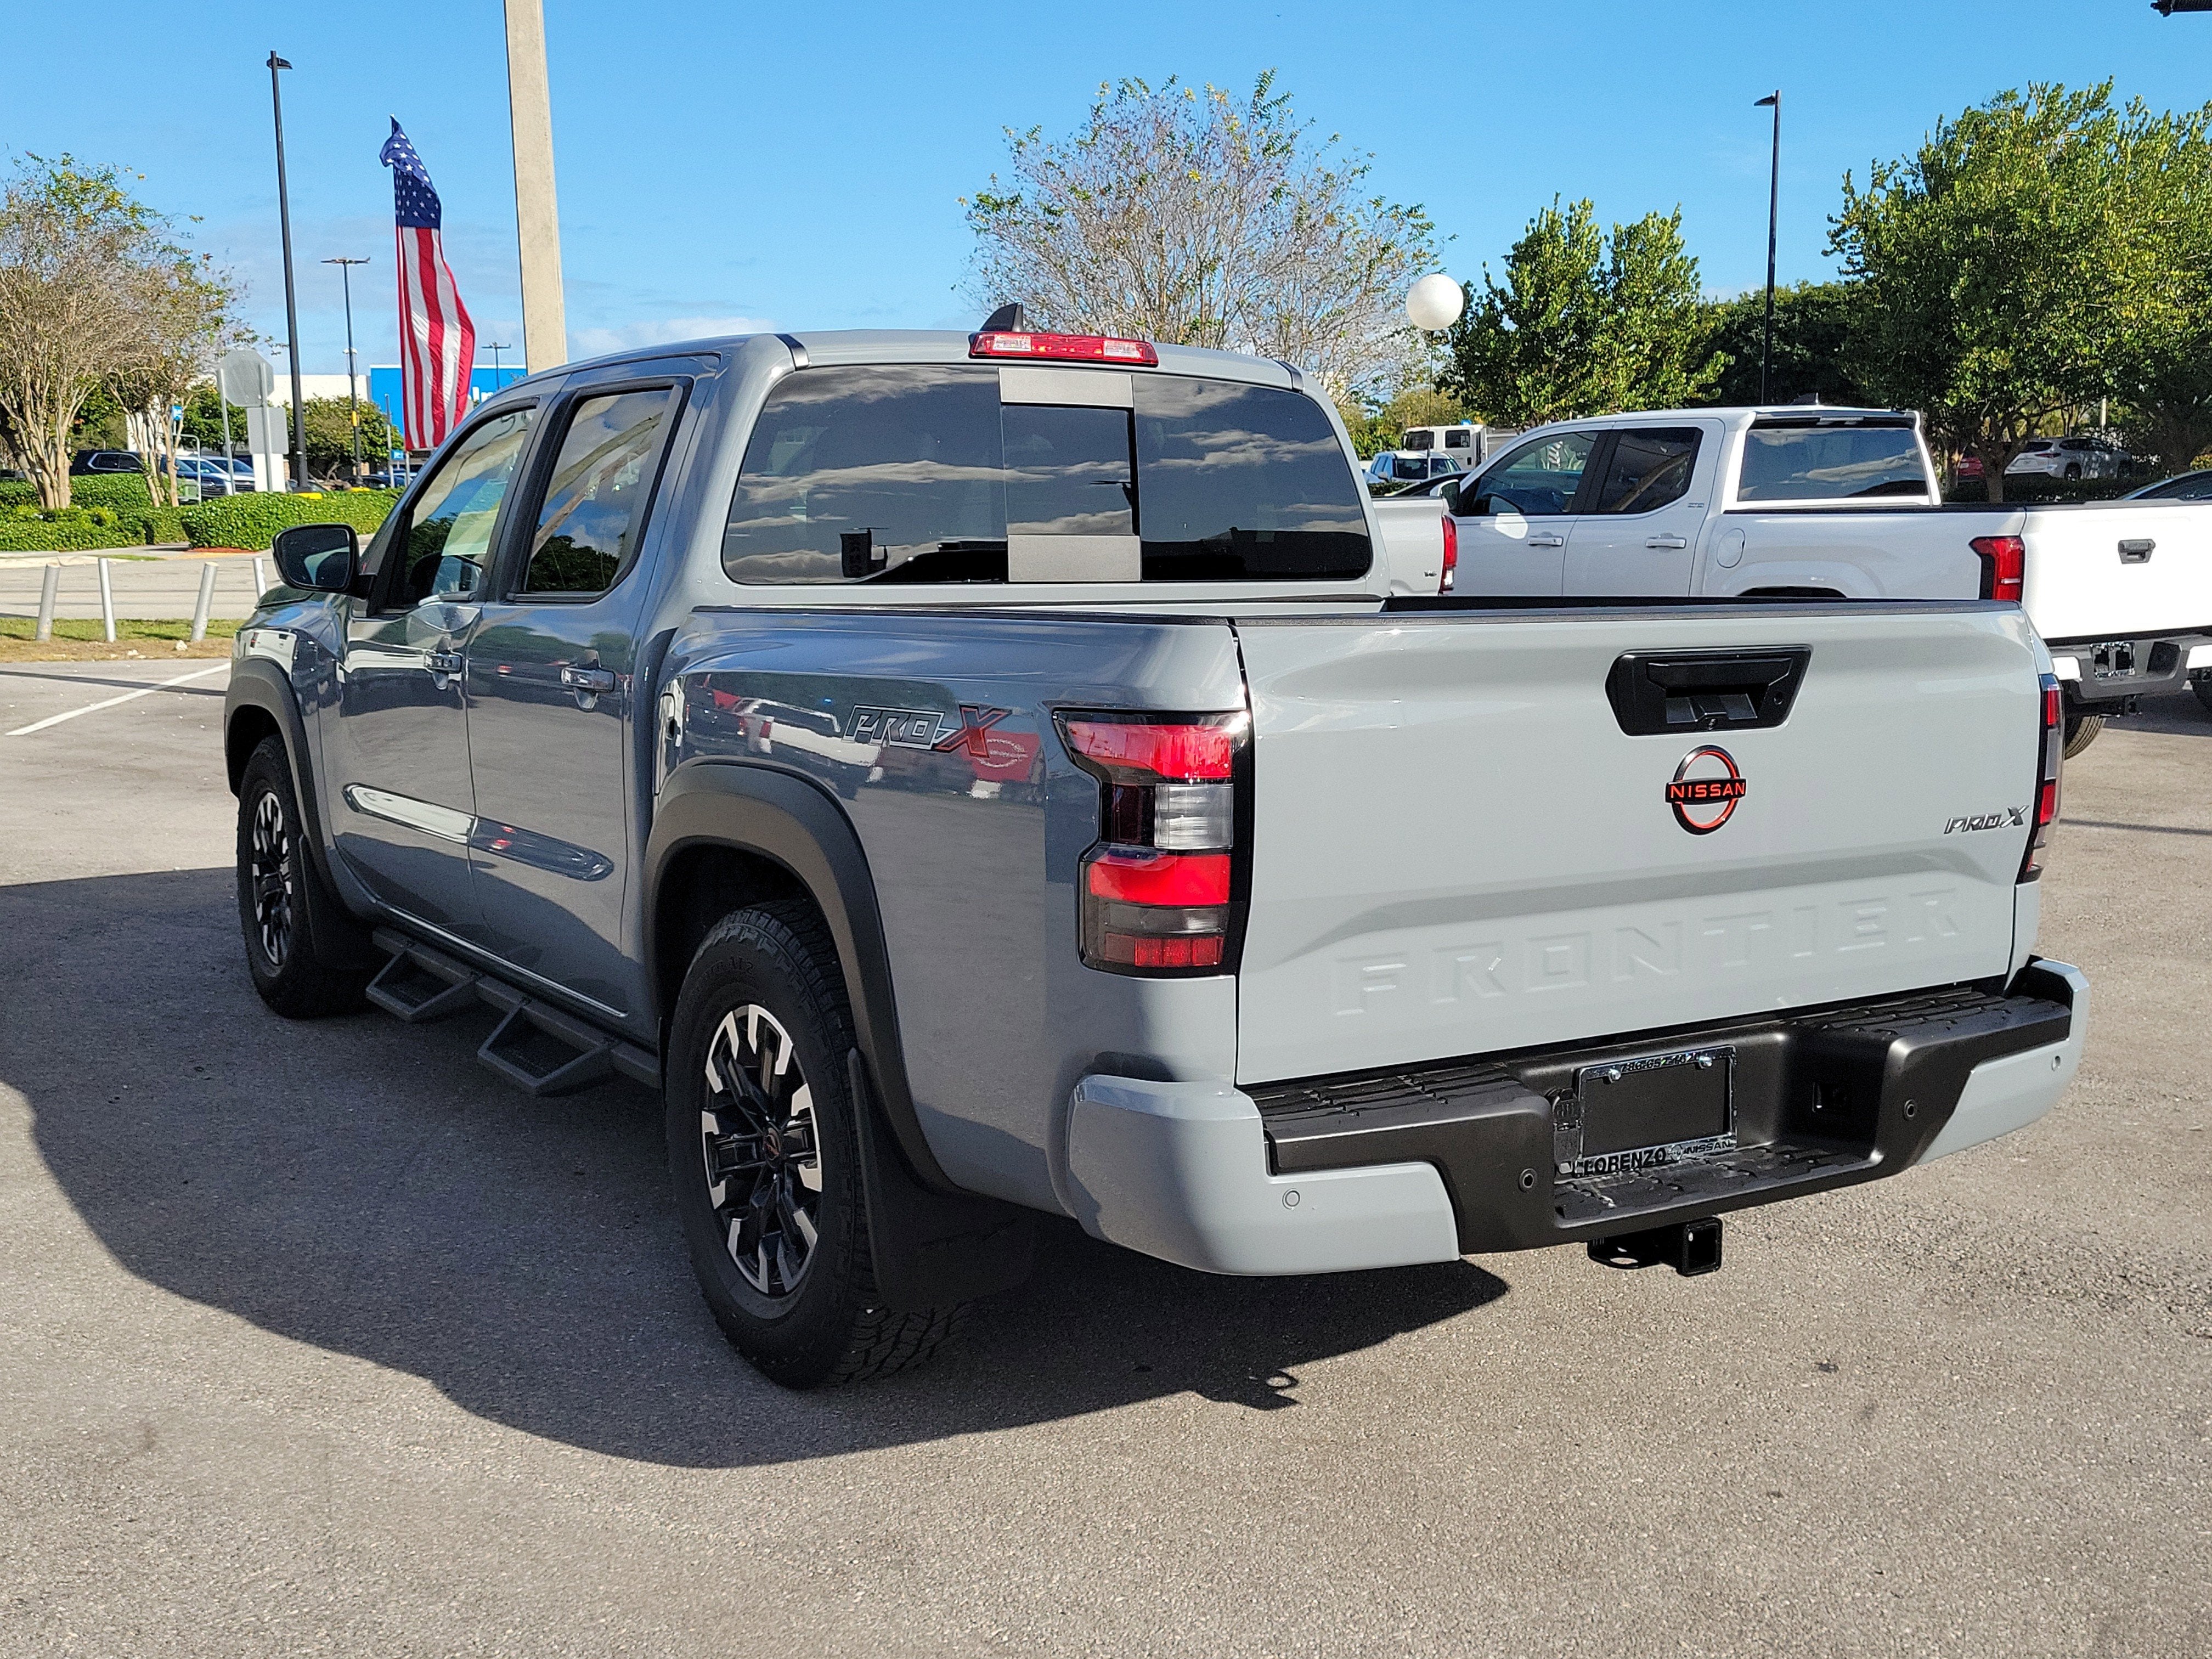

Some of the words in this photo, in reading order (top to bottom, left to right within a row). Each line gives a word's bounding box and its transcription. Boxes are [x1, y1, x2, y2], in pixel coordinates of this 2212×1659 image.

[1671, 782, 1745, 798] NISSAN
[1335, 888, 1957, 1018] FRONTIER
[1584, 1147, 1666, 1175] LORENZO
[1684, 1139, 1731, 1154] NISSAN
